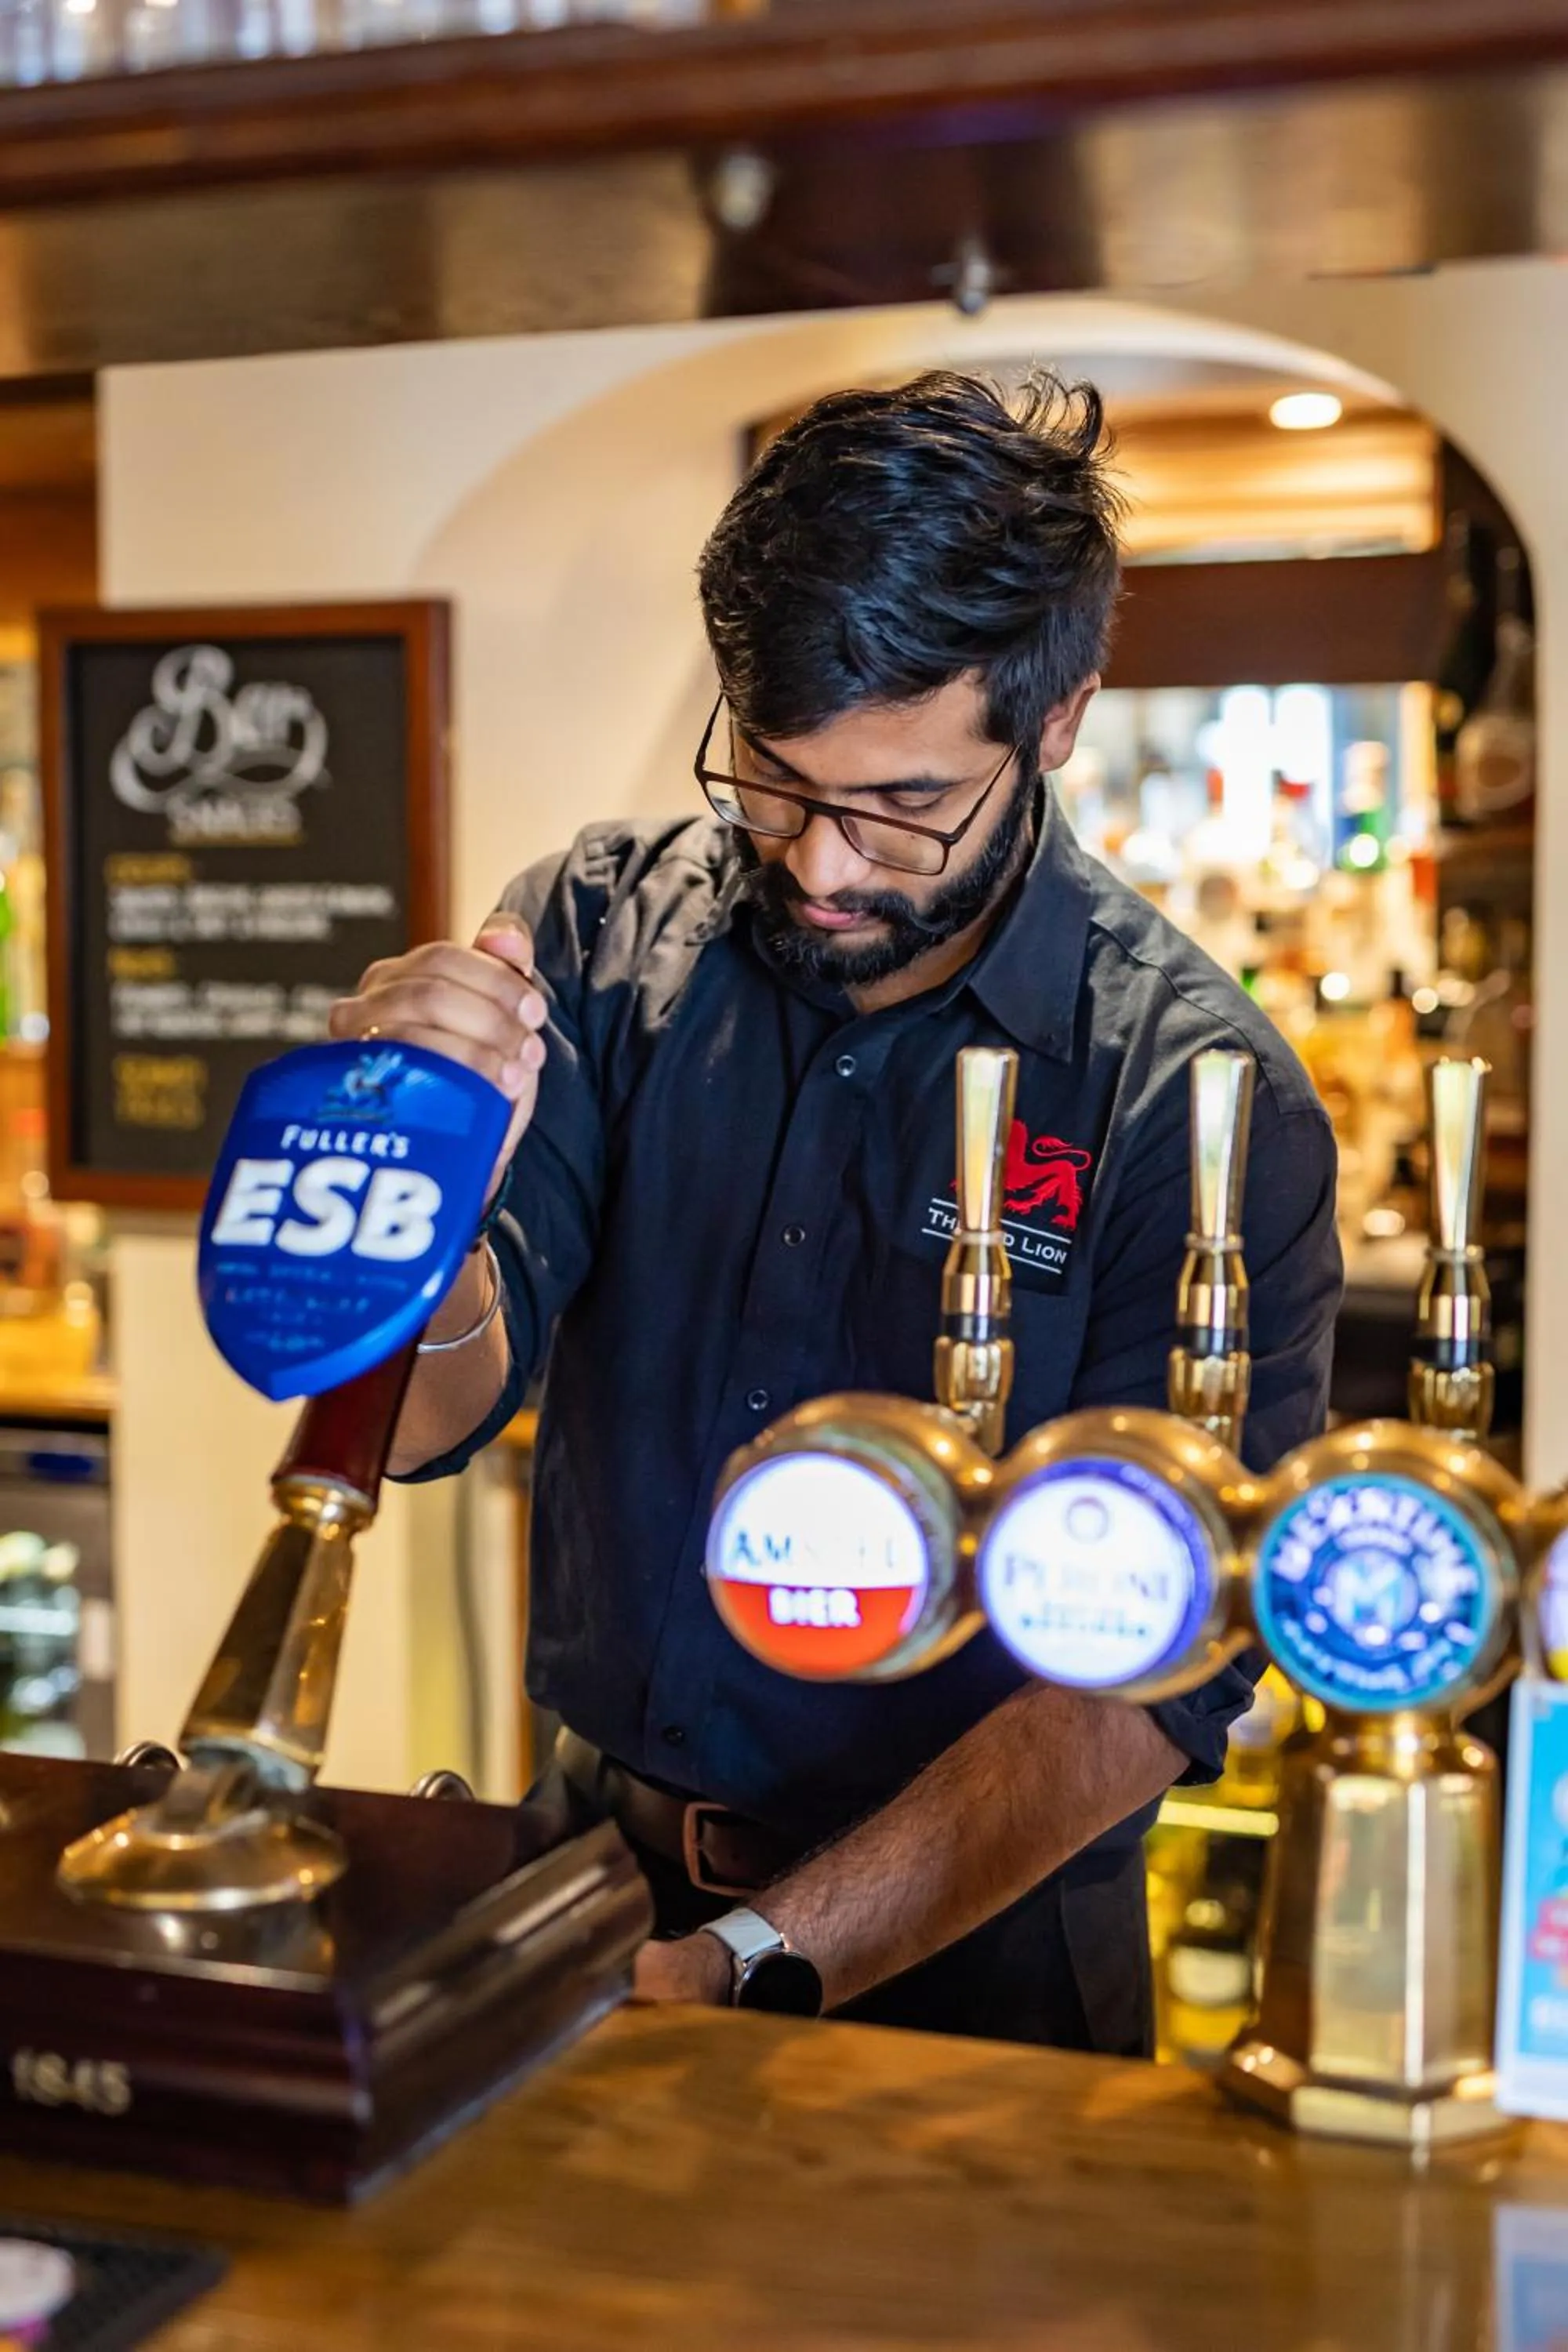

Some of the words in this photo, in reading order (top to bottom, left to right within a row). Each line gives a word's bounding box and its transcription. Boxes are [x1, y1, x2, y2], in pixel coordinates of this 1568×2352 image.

[281, 1125, 409, 1159] FULLER'S
[211, 1156, 441, 1261] ESB
[928, 1207, 960, 1231] TH
[1022, 1236, 1068, 1265] LION
